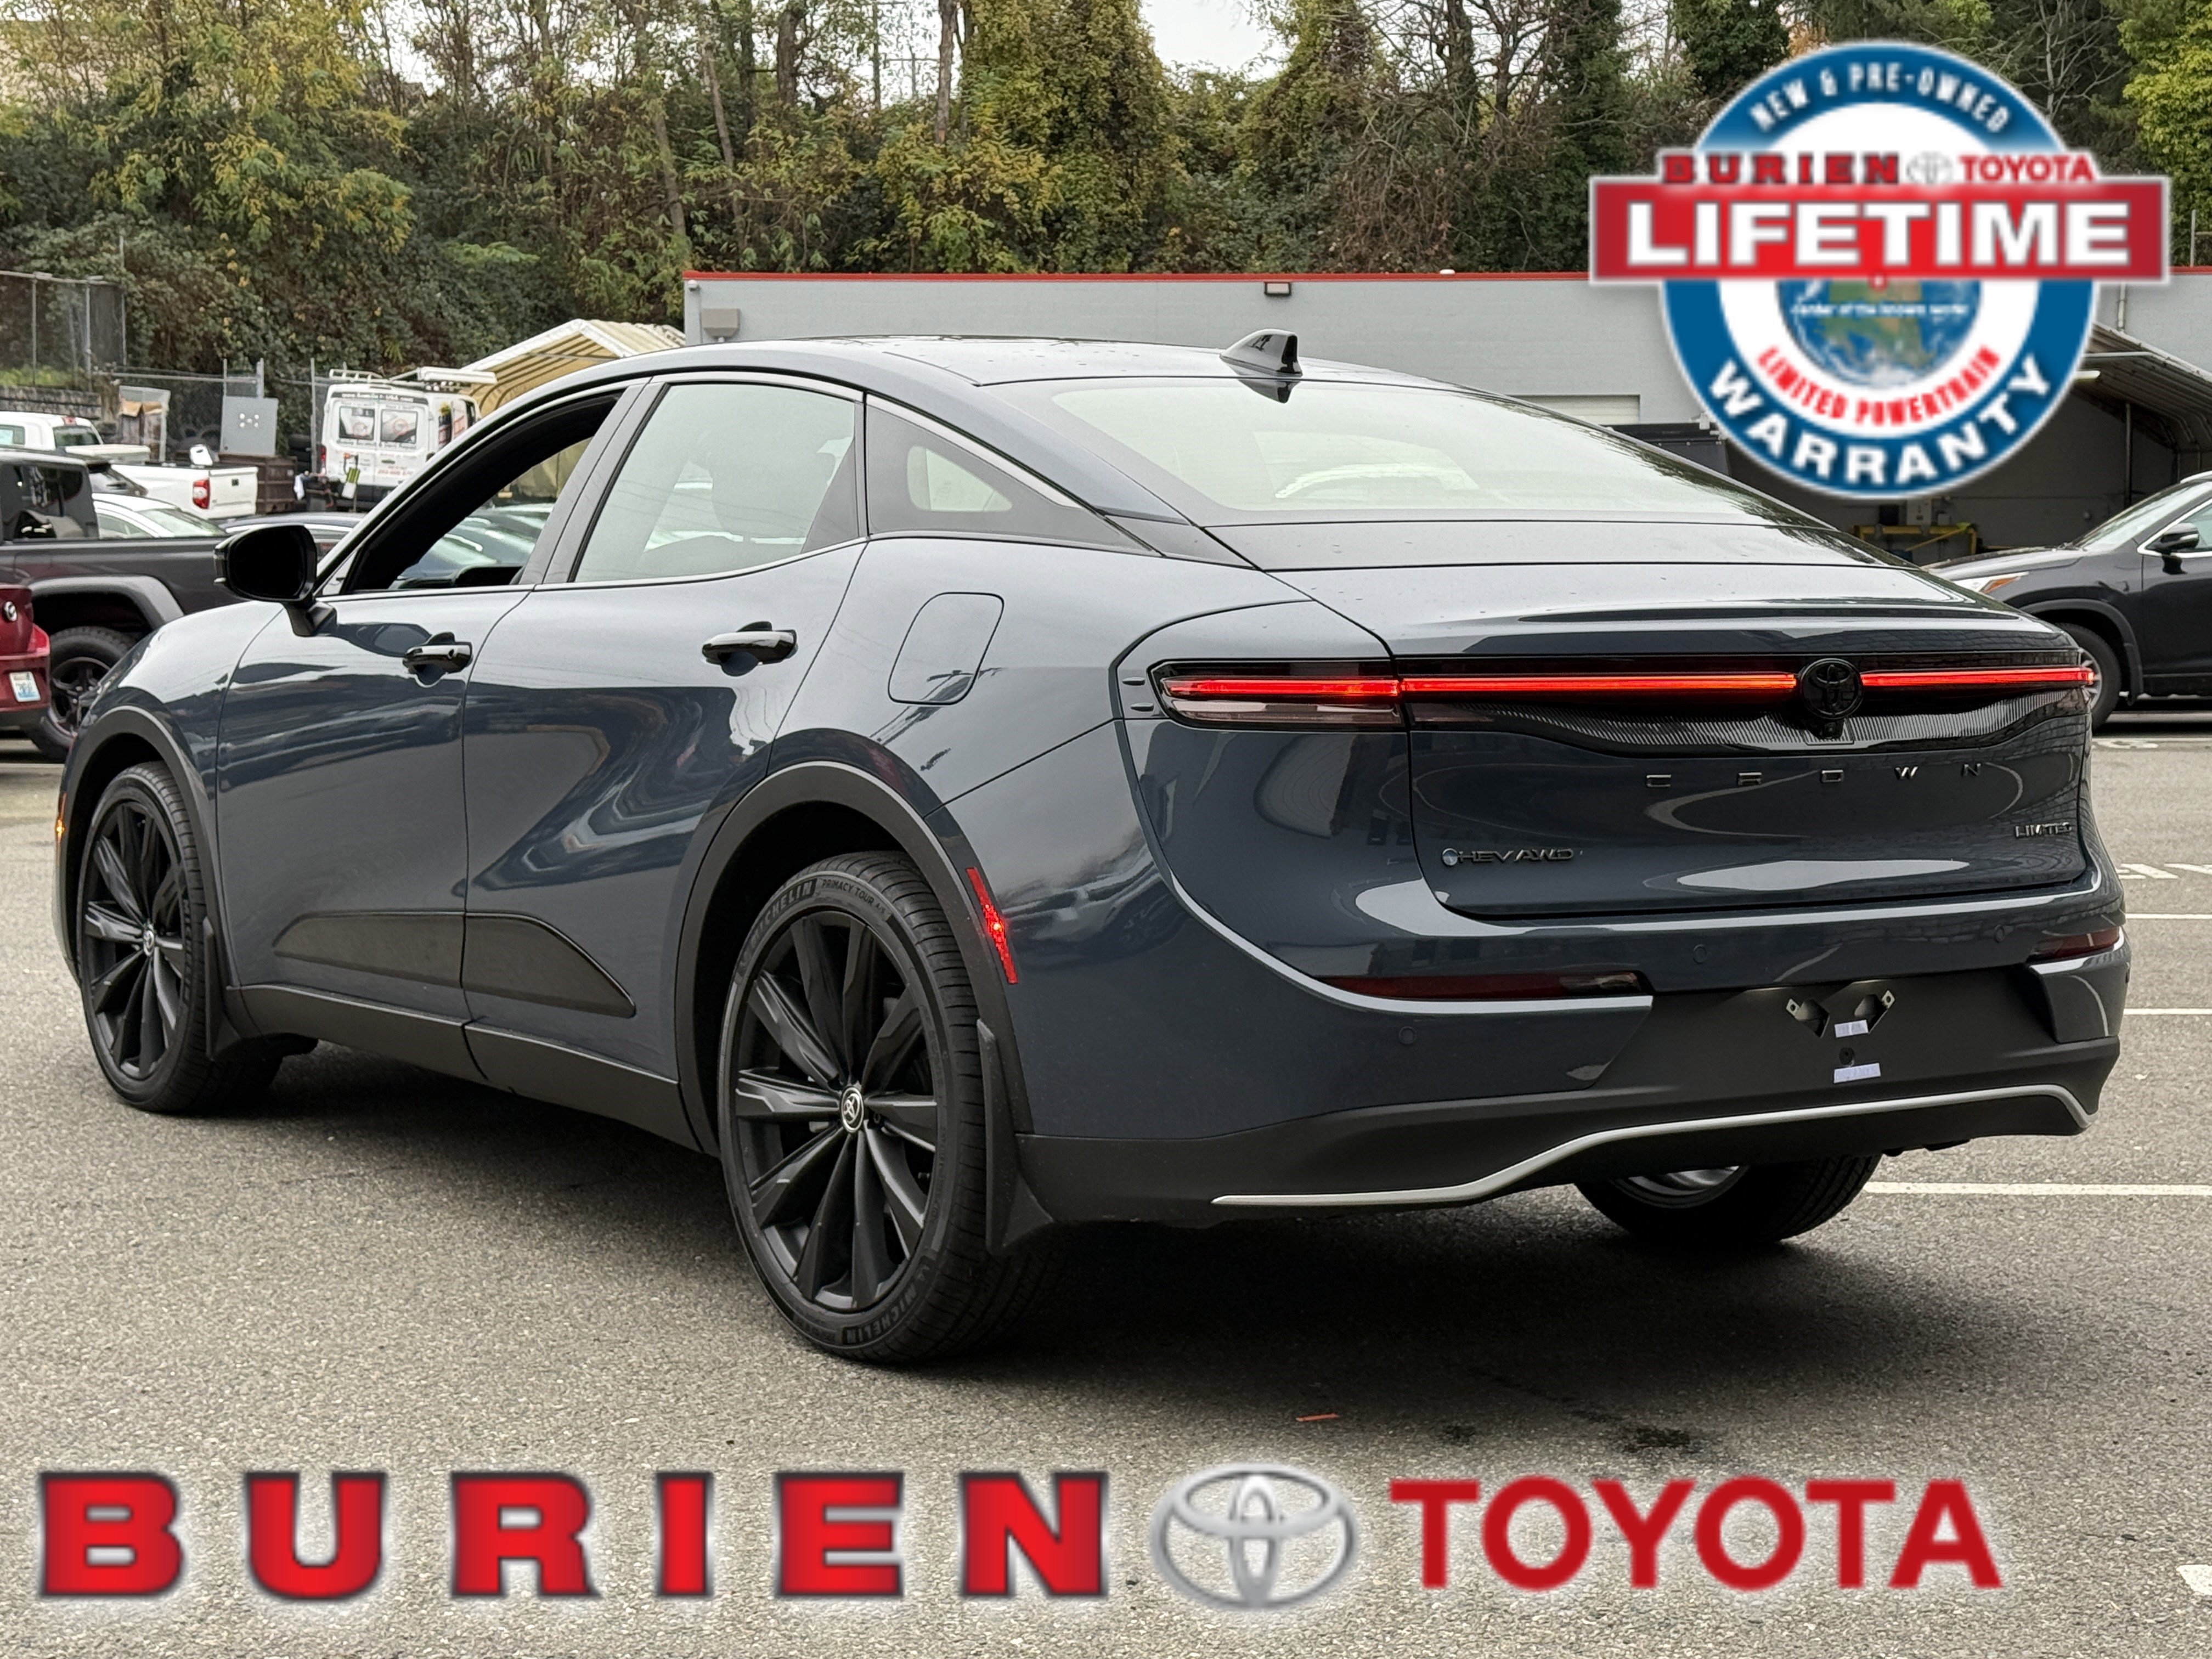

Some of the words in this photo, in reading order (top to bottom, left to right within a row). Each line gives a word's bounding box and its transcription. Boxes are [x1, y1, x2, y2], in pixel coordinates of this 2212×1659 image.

[1646, 763, 1981, 788] CROWN
[822, 879, 853, 892] PRIMACY
[855, 889, 874, 904] TOUR
[749, 879, 815, 948] MICHELIN
